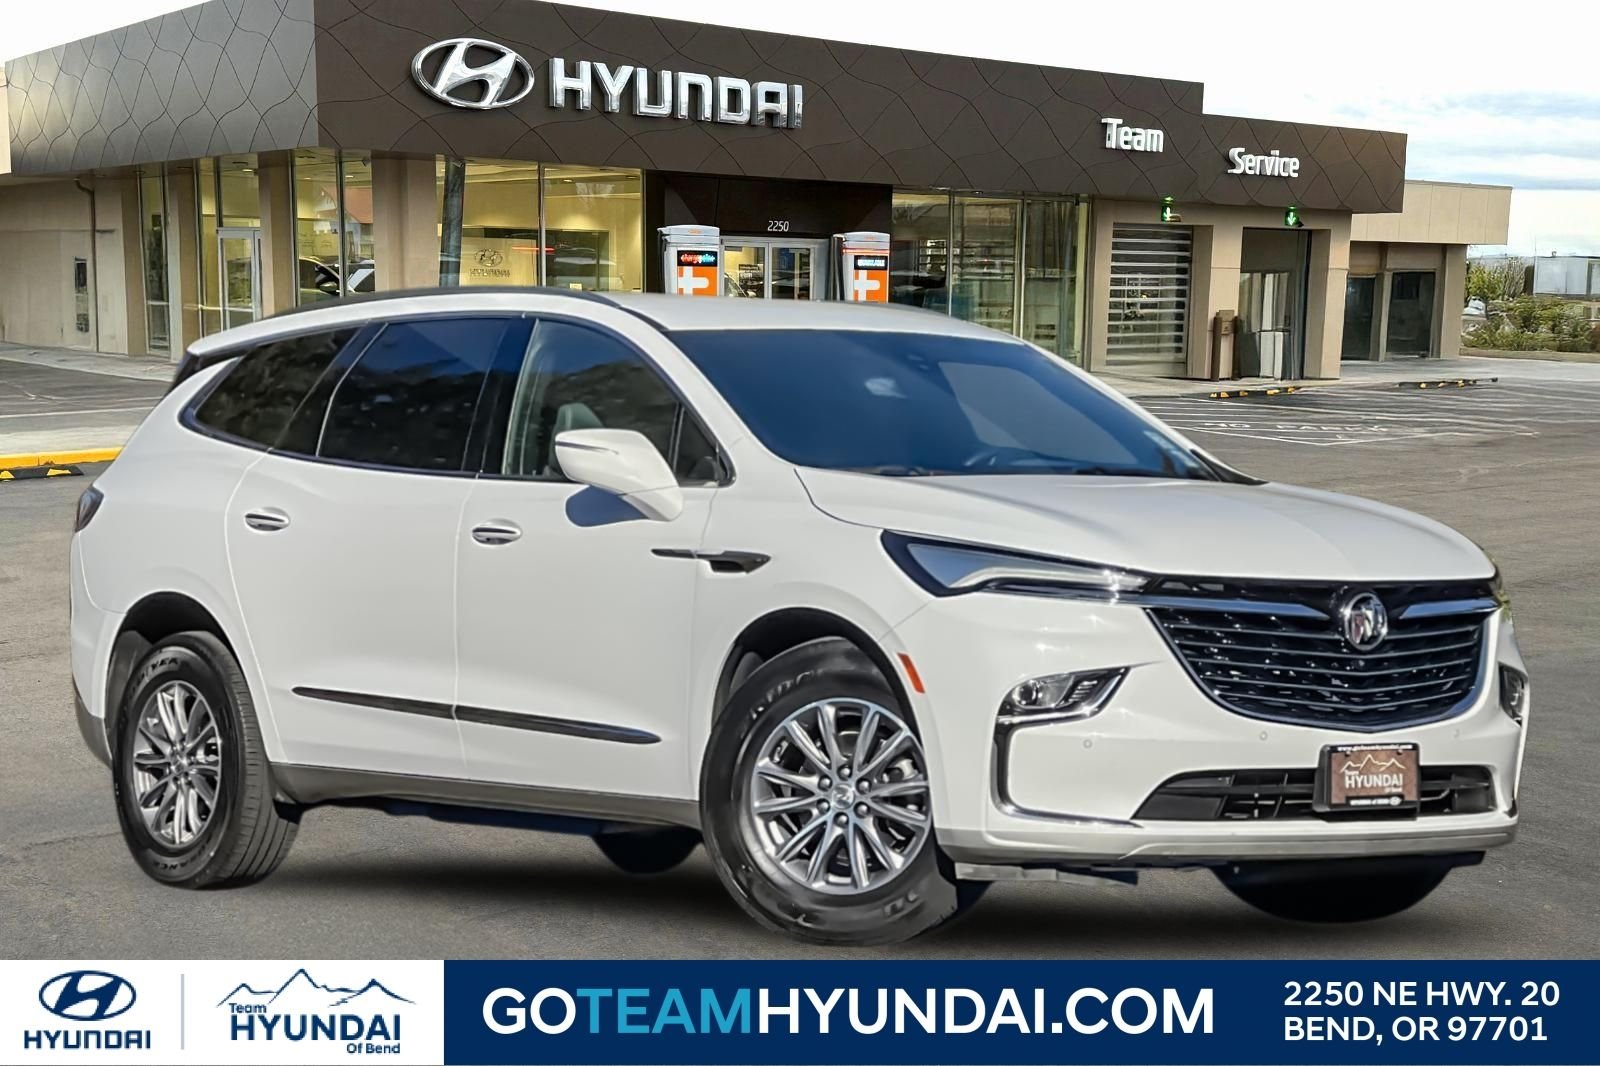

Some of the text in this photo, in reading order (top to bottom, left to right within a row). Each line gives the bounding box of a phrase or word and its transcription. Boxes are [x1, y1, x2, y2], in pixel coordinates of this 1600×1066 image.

[548, 57, 803, 129] HYUNDAI
[1101, 117, 1164, 153] Team
[1227, 147, 1300, 178] Service
[767, 220, 790, 232] 2250
[1345, 773, 1404, 789] HYUNDAI
